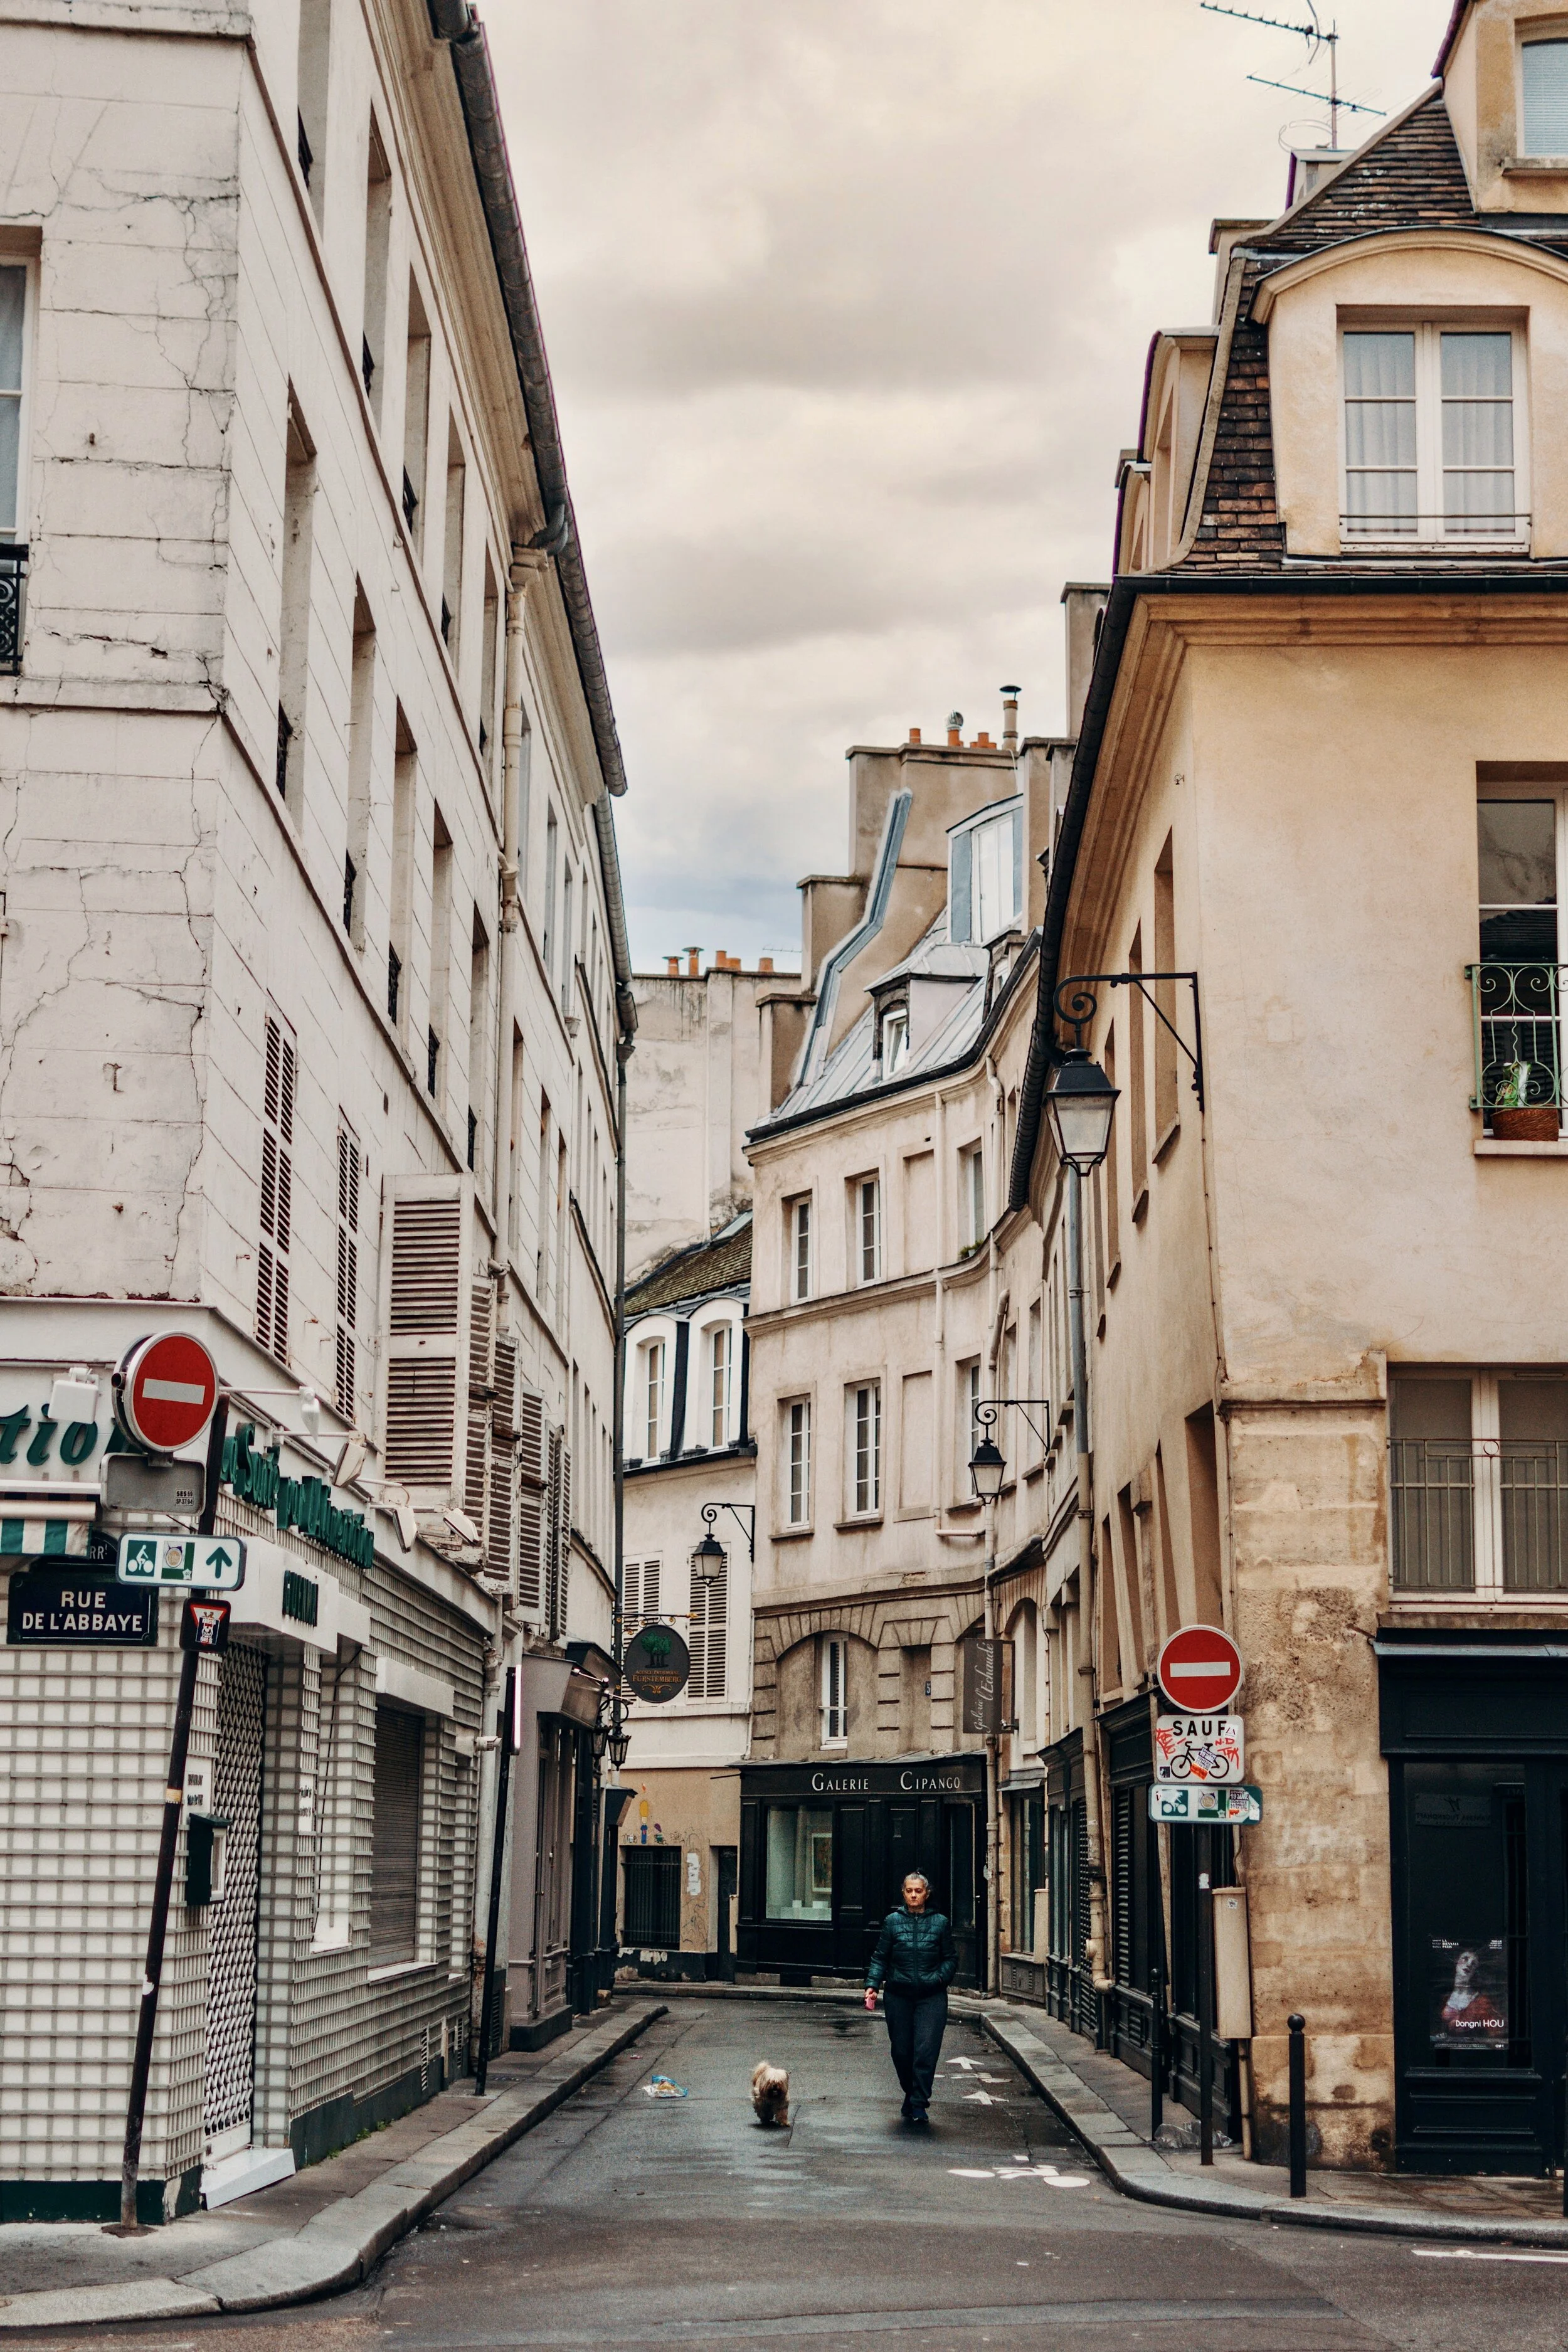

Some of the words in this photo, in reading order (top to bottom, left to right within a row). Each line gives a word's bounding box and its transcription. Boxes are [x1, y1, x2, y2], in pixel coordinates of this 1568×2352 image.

[61, 1591, 106, 1608] RUE
[22, 1613, 44, 1629] DE
[50, 1613, 142, 1631] L'ABBAYE
[1172, 1720, 1227, 1736] SAUF
[812, 1772, 869, 1791] GALERIE
[900, 1771, 960, 1790] CIPANGO
[1455, 2020, 1481, 2028] Dongni
[1483, 2019, 1504, 2027] HOU
